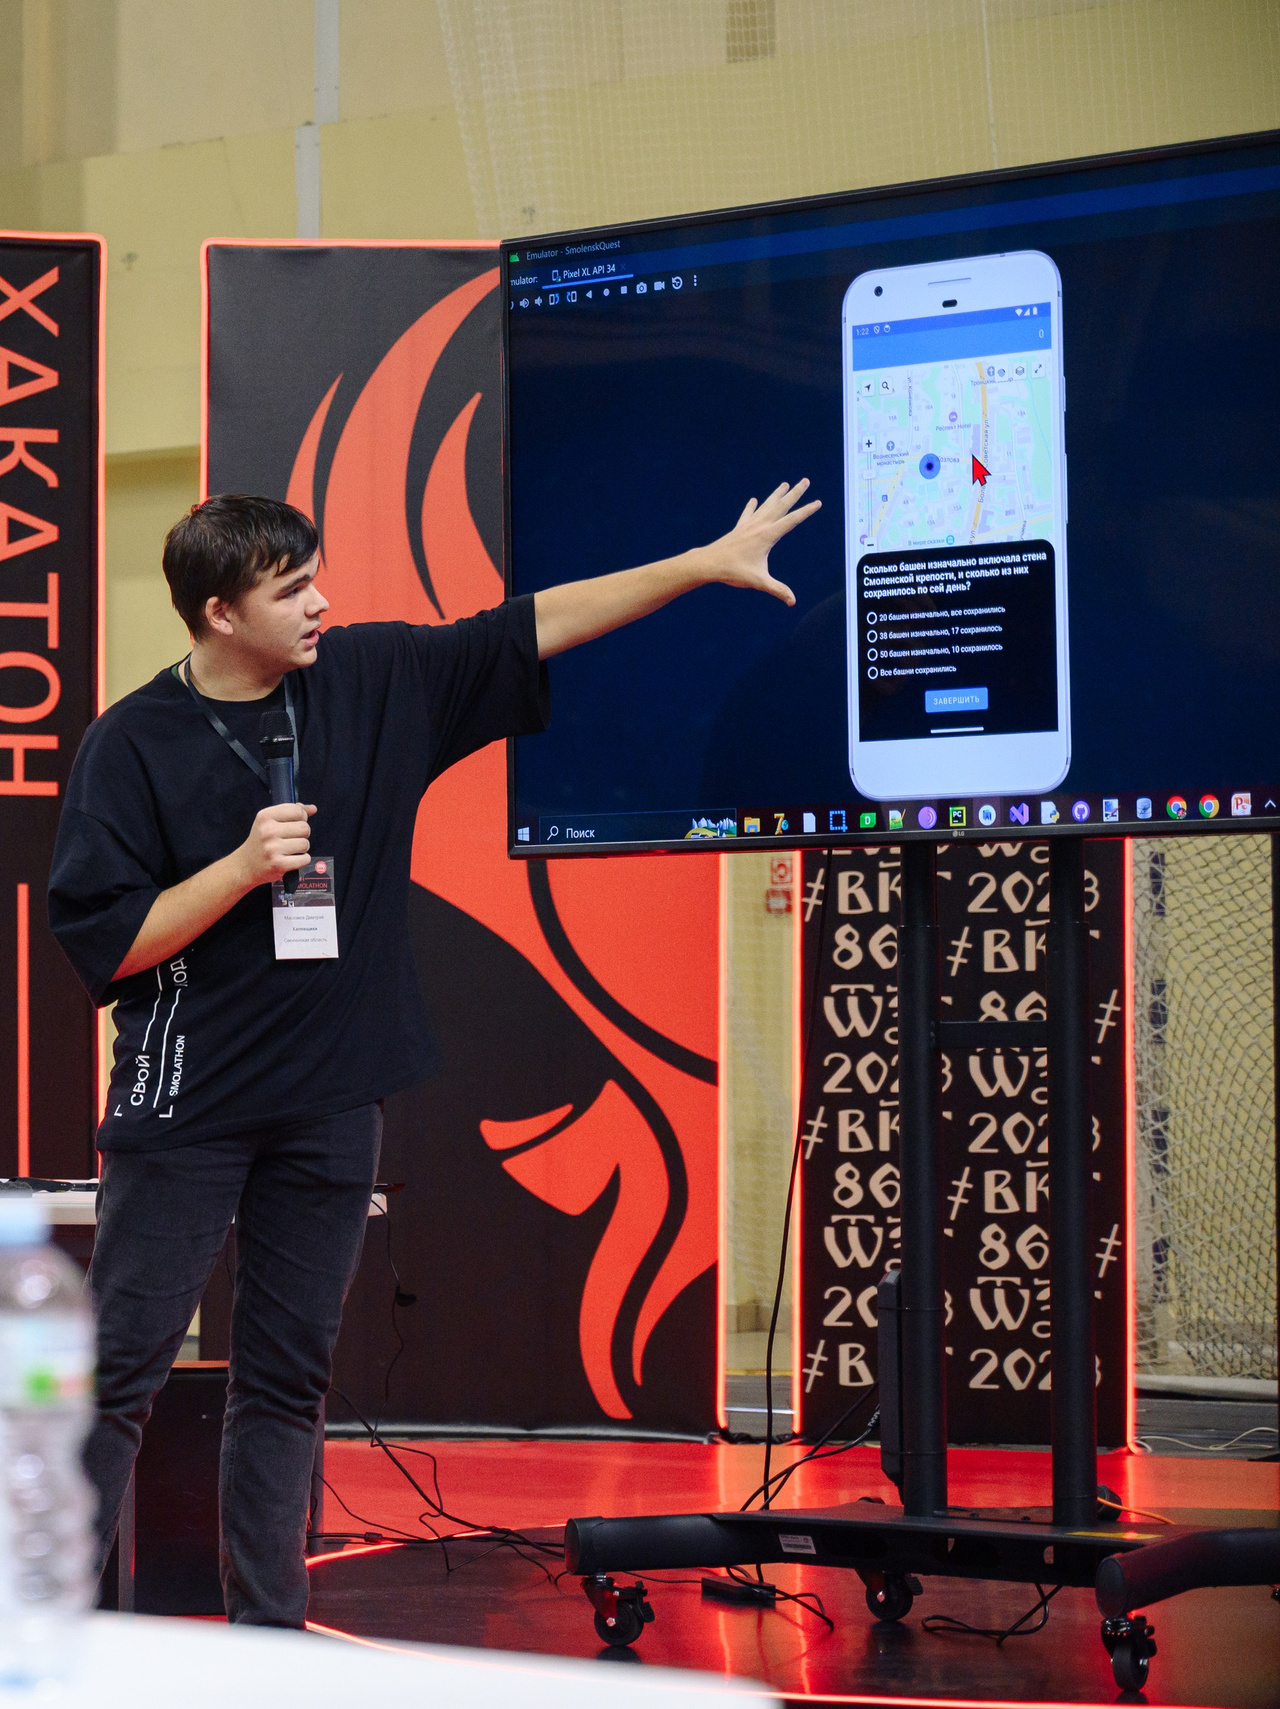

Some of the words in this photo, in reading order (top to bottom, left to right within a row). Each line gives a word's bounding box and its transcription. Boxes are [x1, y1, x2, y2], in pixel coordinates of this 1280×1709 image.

[526, 250, 559, 261] Emulator
[565, 240, 621, 255] SmolenskQuest
[563, 268, 580, 279] Pixel
[582, 267, 591, 277] XL
[592, 265, 605, 275] API
[607, 263, 616, 273] 34
[510, 275, 538, 287] mulator:
[957, 423, 971, 431] Hotel
[873, 450, 909, 460] Вознесенский
[876, 459, 905, 467] монастырь
[863, 564, 898, 574] Сколько
[899, 562, 926, 571] башен
[927, 559, 977, 569] изначально
[978, 554, 1020, 565] включала
[1022, 552, 1047, 562] стена
[863, 573, 914, 586] Смоленской
[916, 572, 957, 584] крепости,
[958, 571, 964, 579] и
[965, 568, 1000, 579] сколько
[1001, 567, 1012, 575] из
[1013, 566, 1029, 575] них
[863, 587, 916, 600] сохранилось
[917, 586, 928, 594] по
[929, 583, 944, 593] сей
[945, 581, 971, 594] день?
[879, 613, 888, 622] 20
[888, 613, 910, 621] башен
[910, 611, 950, 619] изначально,
[879, 631, 888, 640] 38
[888, 631, 910, 639] башен
[910, 629, 951, 638] изначально,
[951, 626, 960, 635] 17
[880, 650, 889, 659] 50
[888, 650, 910, 658] башен
[910, 647, 951, 656] изначально,
[951, 645, 960, 654] 10
[960, 644, 1004, 654] сохранилось
[880, 668, 893, 677] Все
[892, 667, 914, 676] башни
[915, 665, 957, 675] сохранились
[933, 695, 980, 706] ЗАВЕРШИТЬ
[566, 827, 595, 840] Поиск
[832, 923, 898, 970] 86
[979, 990, 1047, 1022] 86
[170, 1035, 185, 1097] SMOLATHON
[130, 1055, 150, 1106] СВОЙ
[832, 1162, 900, 1208] 86
[979, 1223, 1049, 1270] 86
